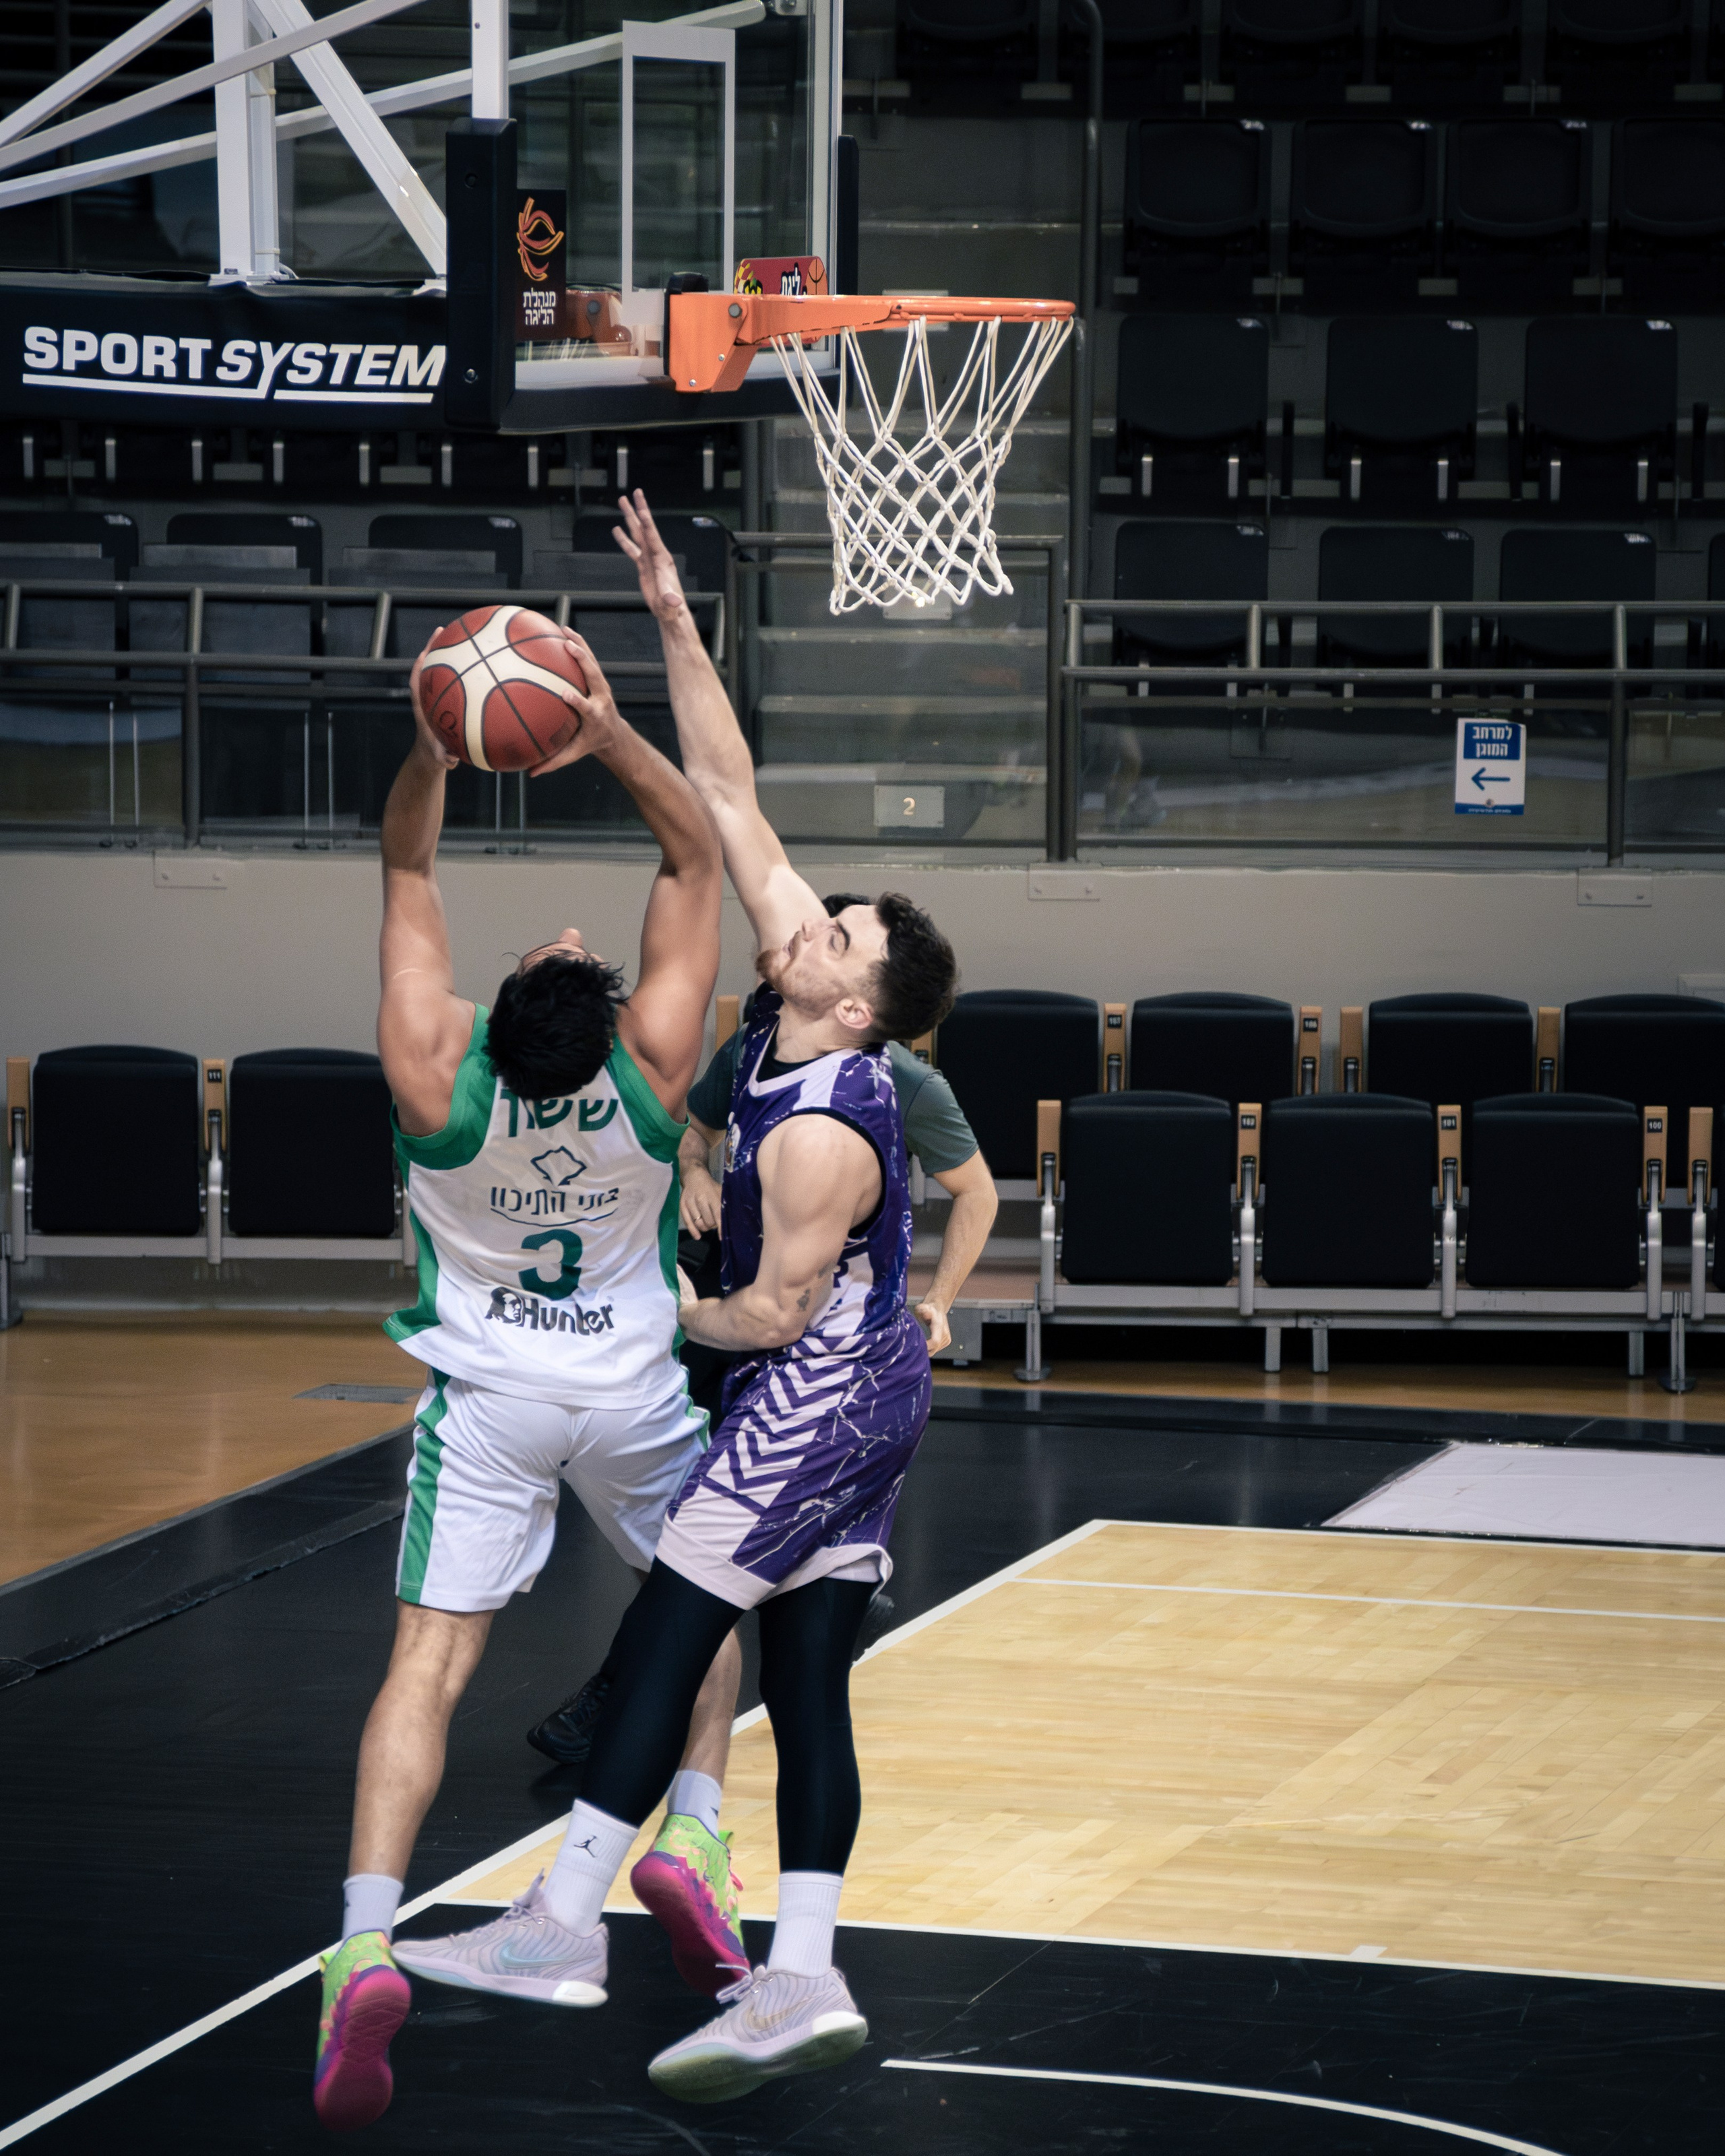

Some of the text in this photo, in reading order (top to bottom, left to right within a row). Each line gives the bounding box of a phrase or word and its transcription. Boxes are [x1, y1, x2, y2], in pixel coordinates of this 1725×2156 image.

[523, 288, 557, 308] מנהלת
[525, 306, 555, 326] הליגה
[24, 326, 447, 399] SPORT SYSTEM
[1472, 725, 1513, 740] למרחב
[1475, 742, 1509, 759] המוגן
[903, 797, 916, 816] 2
[1648, 1121, 1662, 1129] 100
[518, 1229, 584, 1301] 3
[515, 1298, 615, 1336] Hunter
